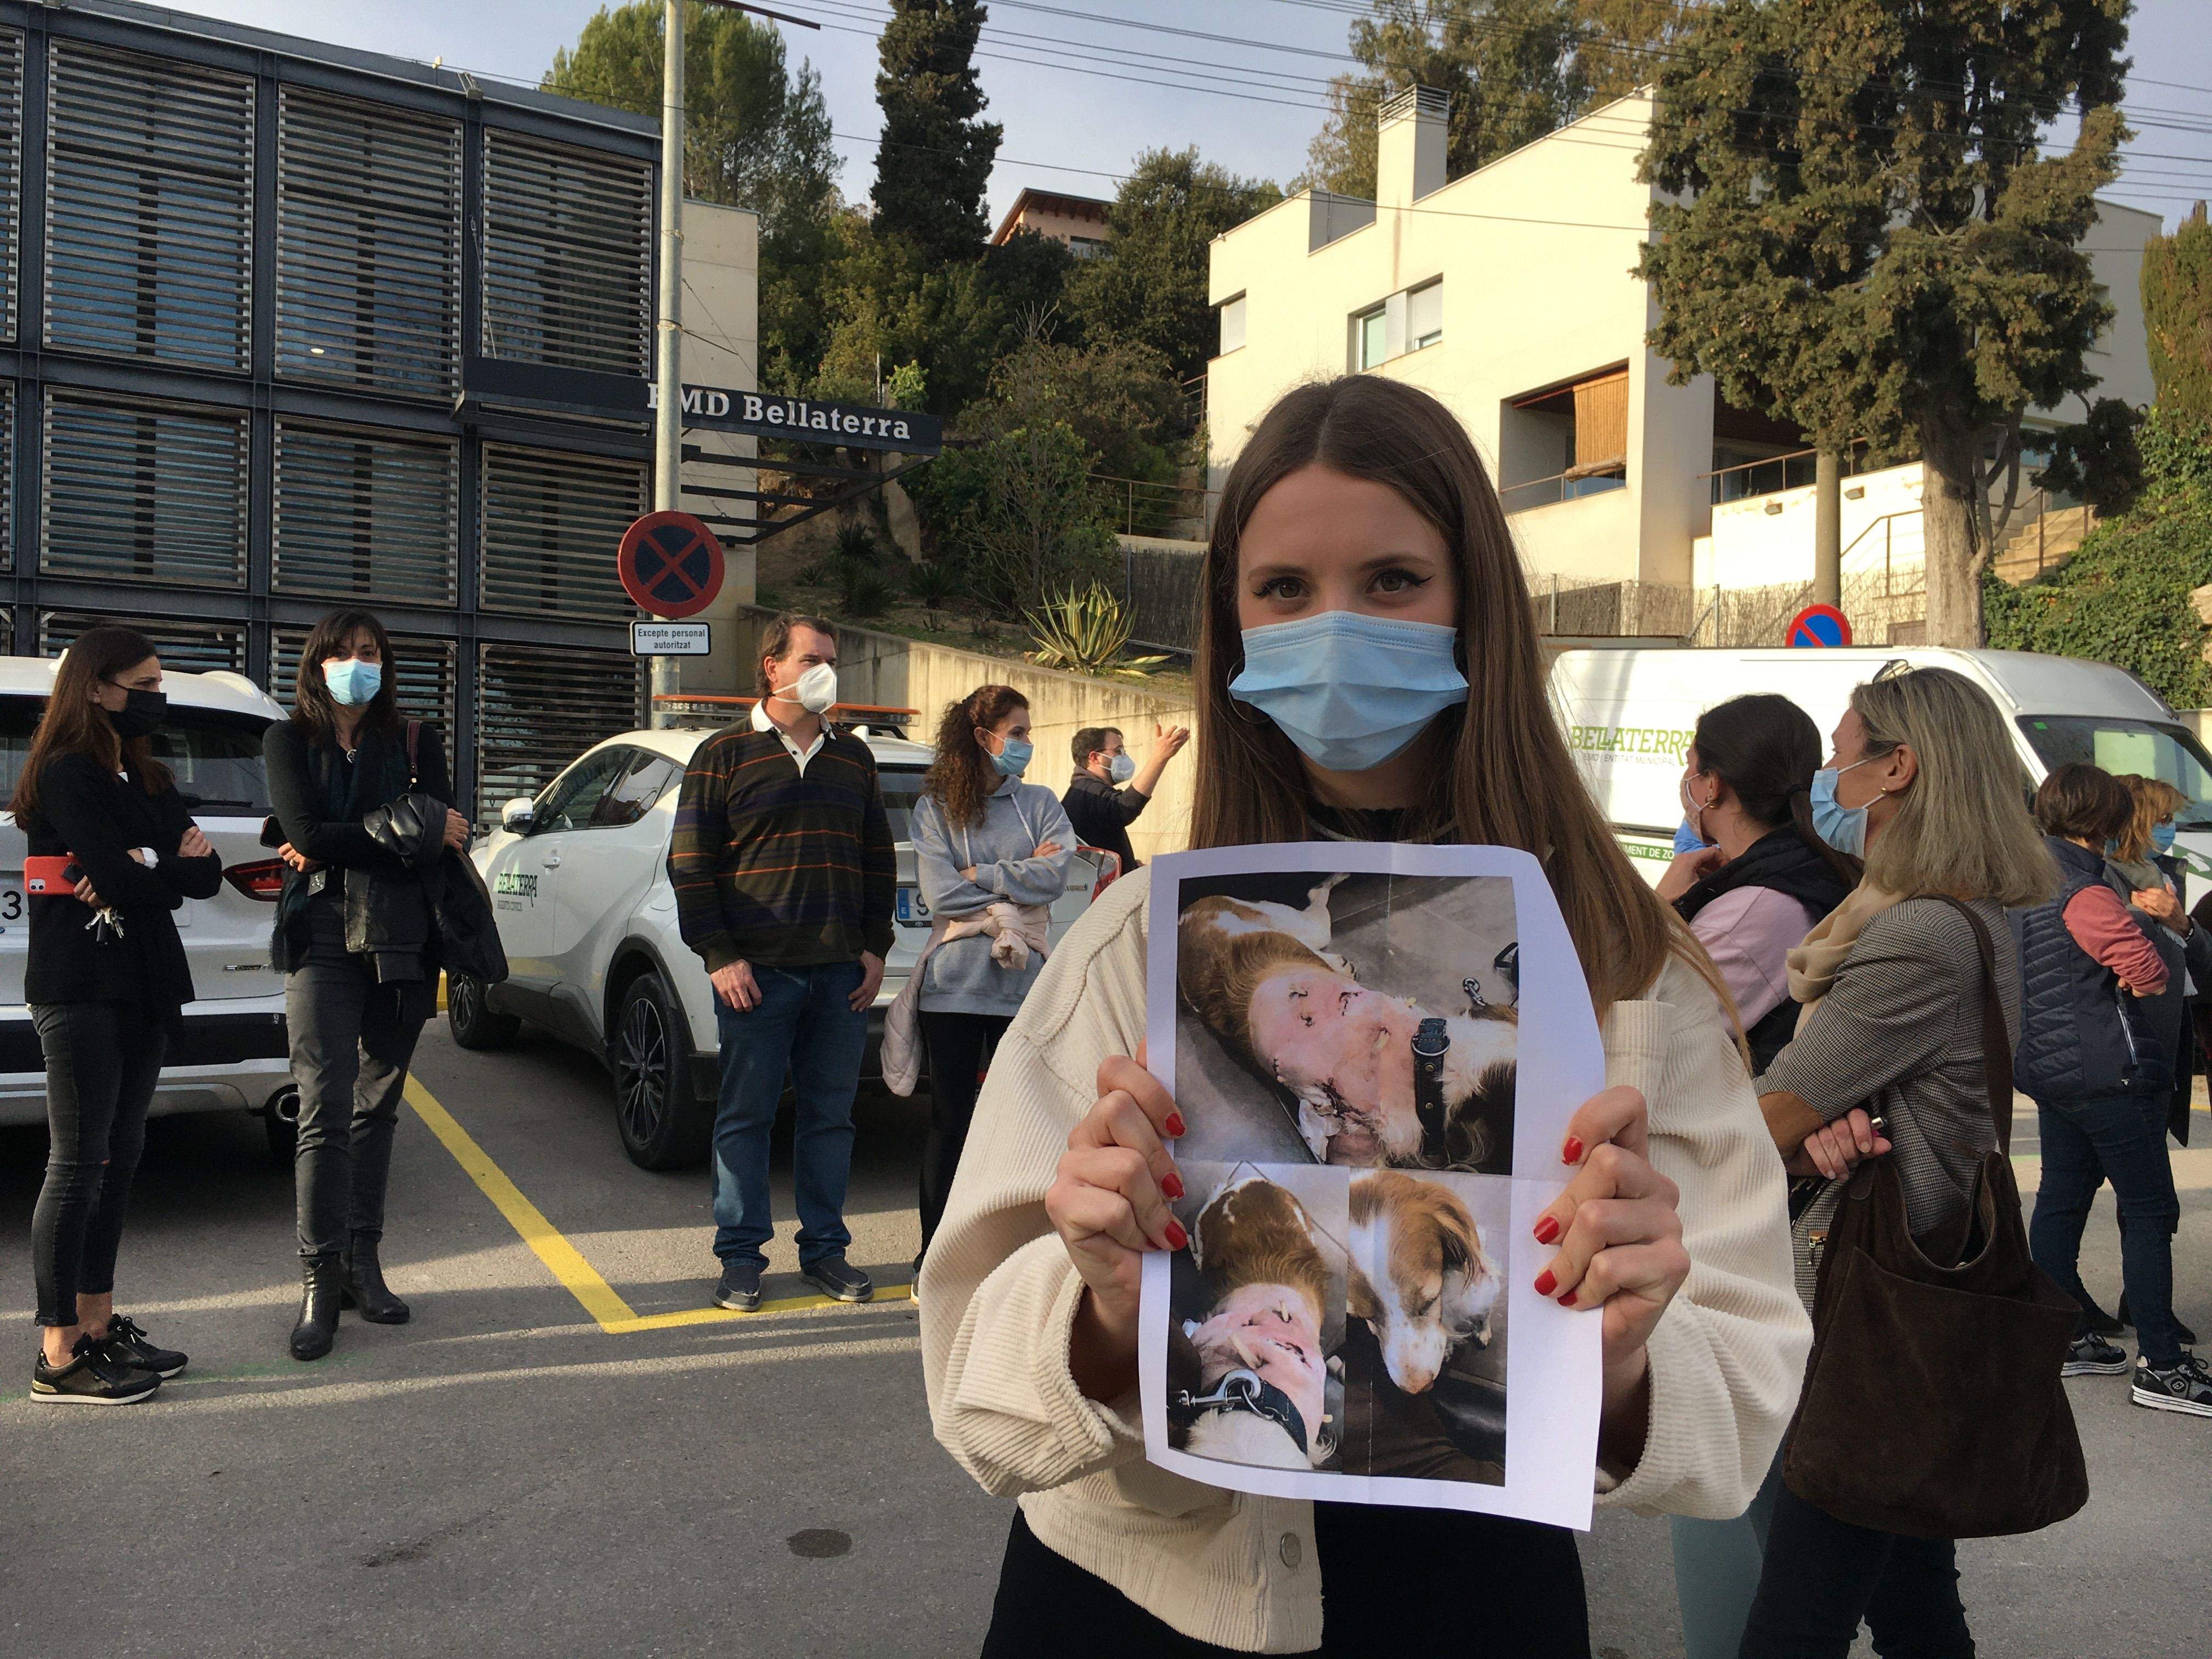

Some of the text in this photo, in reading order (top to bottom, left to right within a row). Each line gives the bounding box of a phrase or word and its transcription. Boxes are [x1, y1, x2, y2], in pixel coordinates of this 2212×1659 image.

[743, 394, 910, 439] Bellaterra
[637, 628, 705, 639] Excepte personal
[653, 641, 691, 649] autoritzat
[1570, 726, 1696, 766] BELLATERRA
[1623, 845, 1675, 860] MENT DE ZO
[2, 890, 22, 920] 3
